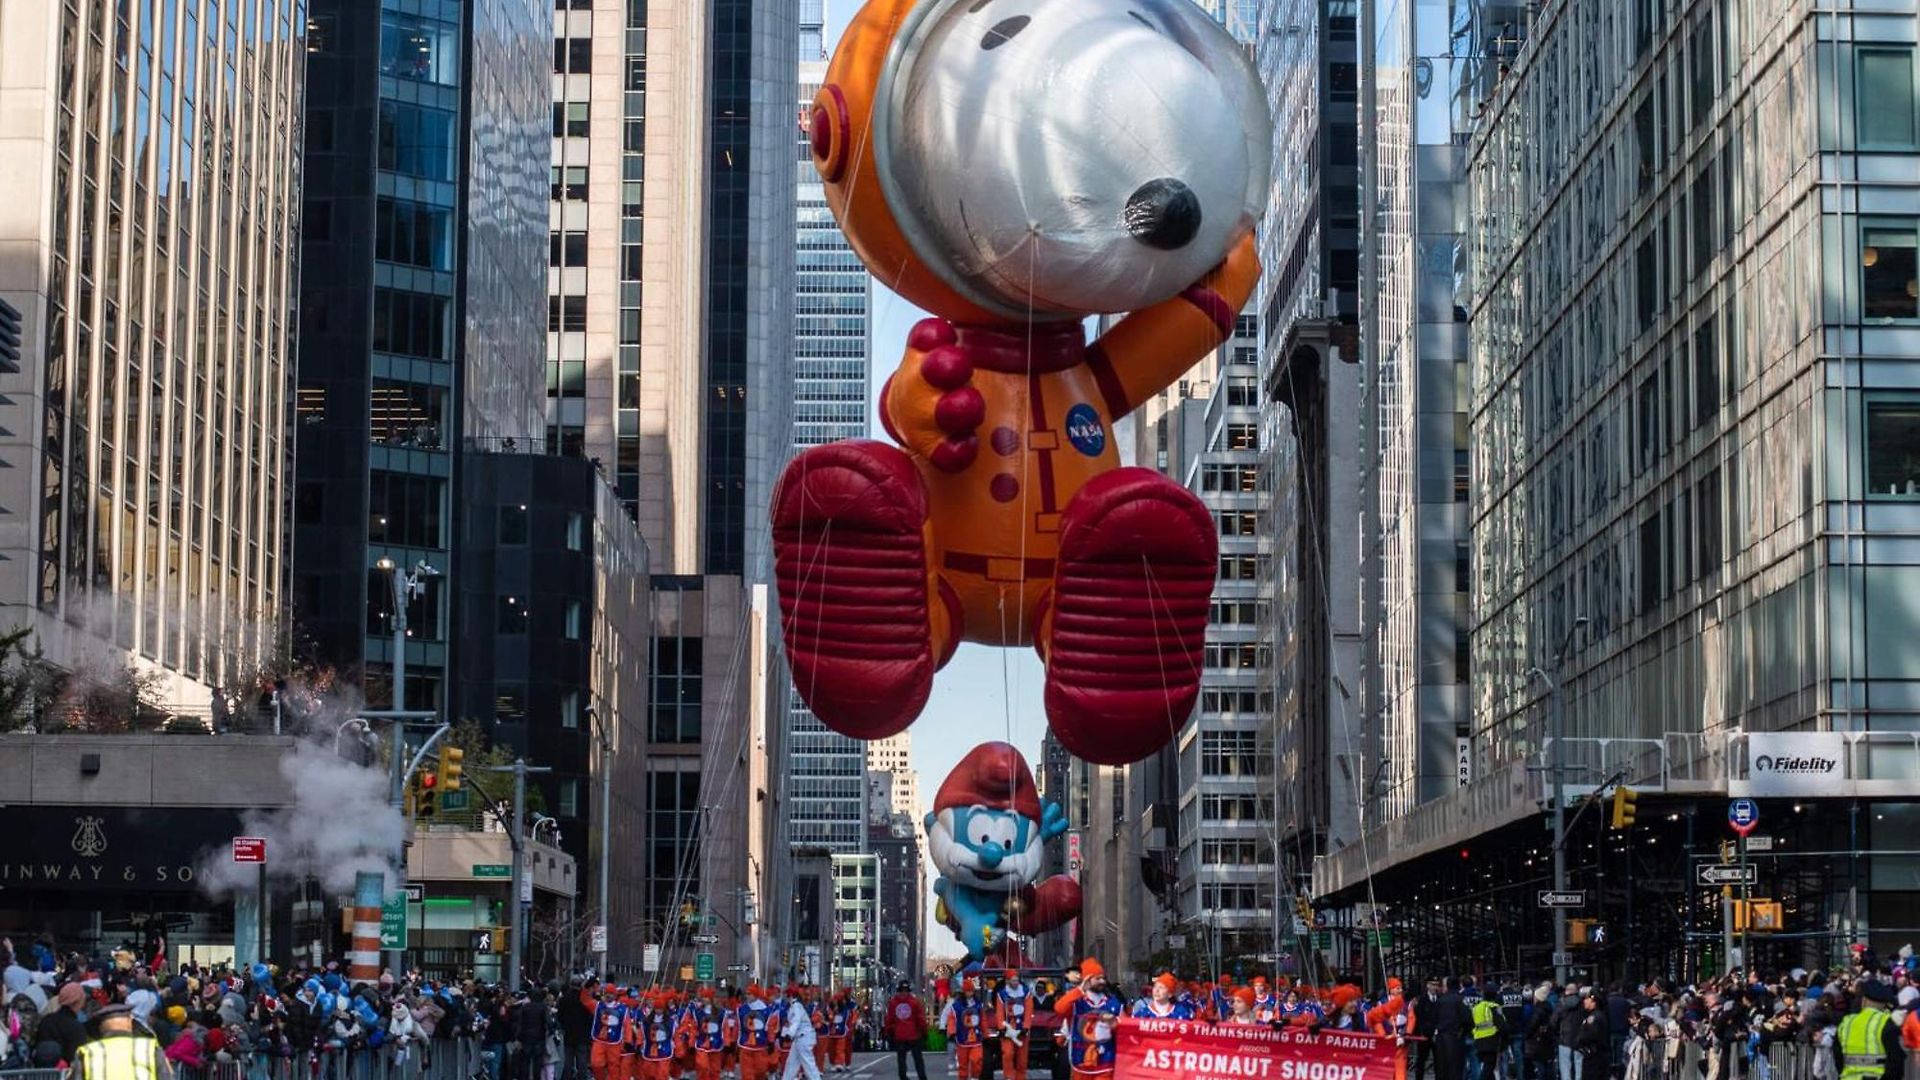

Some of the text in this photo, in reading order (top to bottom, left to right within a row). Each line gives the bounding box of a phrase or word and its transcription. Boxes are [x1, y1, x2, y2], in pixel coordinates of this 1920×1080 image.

[1070, 424, 1103, 438] NASA
[1460, 744, 1468, 786] PARK
[1774, 757, 1836, 773] Fidelity
[123, 866, 136, 880] &
[1139, 1020, 1377, 1050] MACY'S THANKSGIVING DAY PARADE
[1143, 1049, 1367, 1080] ASTRONAUT SNOOPY
